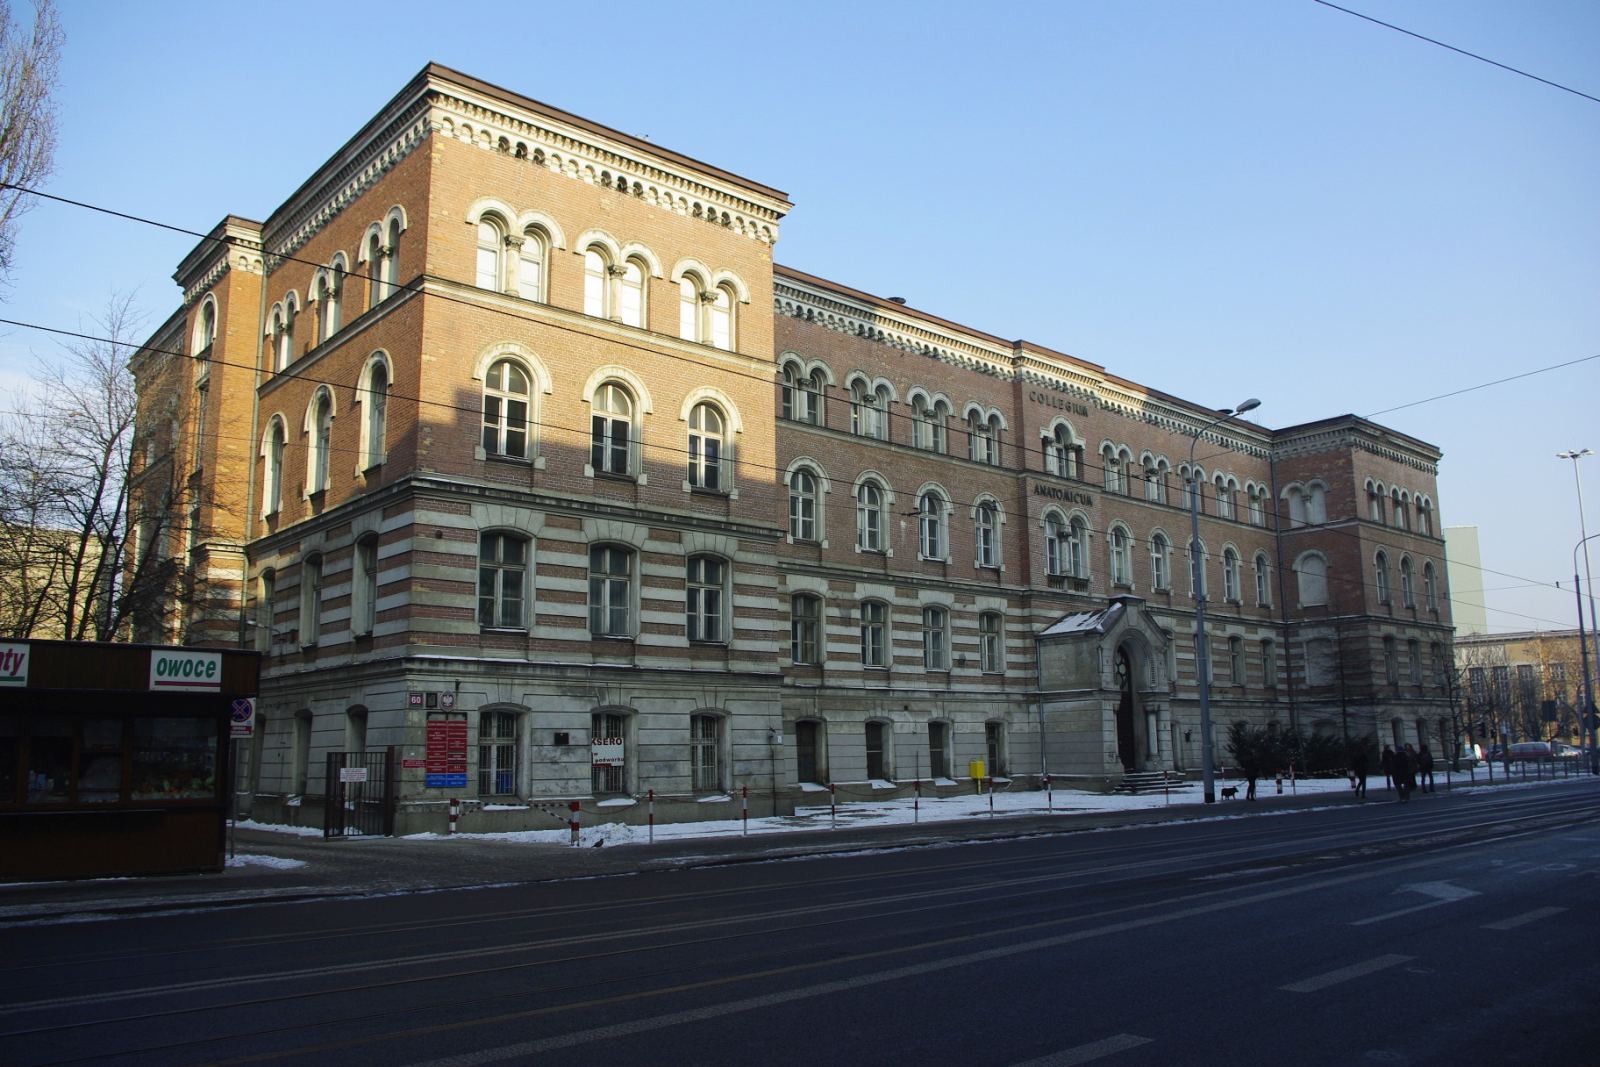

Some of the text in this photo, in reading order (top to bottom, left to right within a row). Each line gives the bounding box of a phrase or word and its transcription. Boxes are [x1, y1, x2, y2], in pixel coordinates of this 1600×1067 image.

[1029, 391, 1088, 417] COLLEGIUM
[1033, 483, 1093, 507] ANATOMICUM
[156, 657, 216, 679] owoce
[411, 696, 421, 704] 60
[592, 738, 622, 746] KSERO
